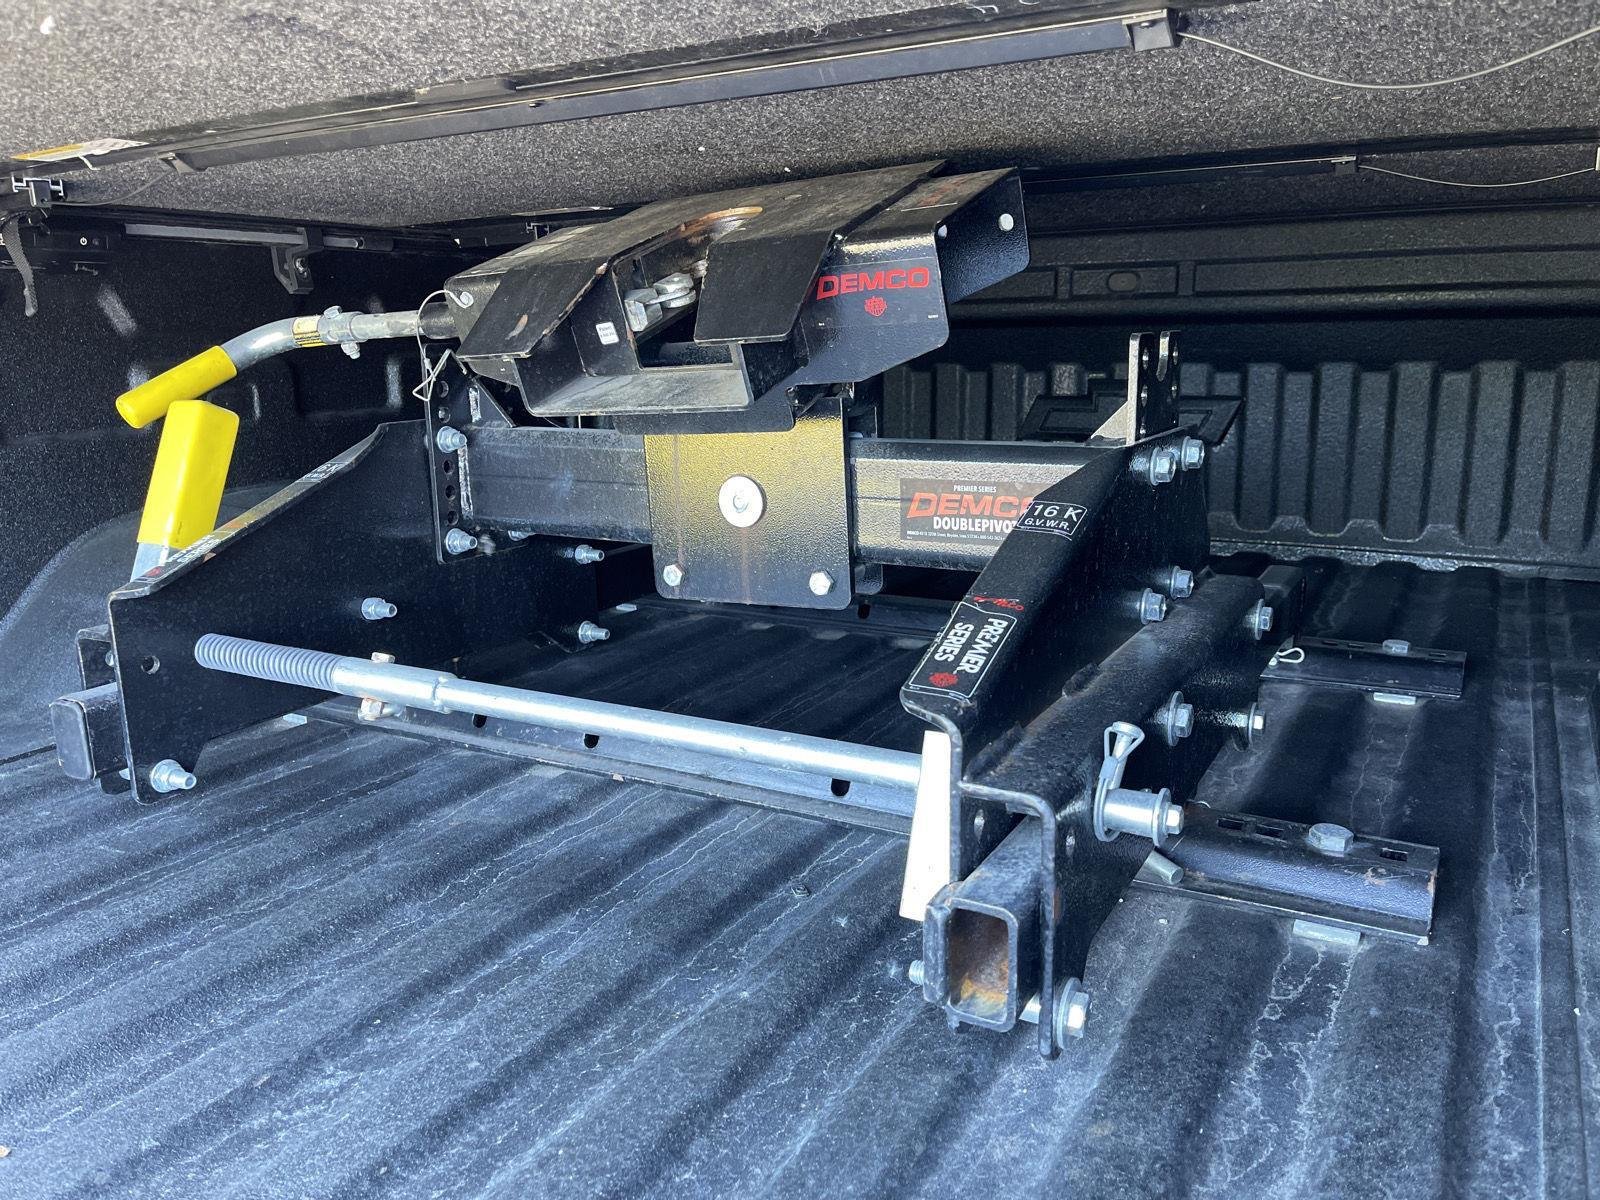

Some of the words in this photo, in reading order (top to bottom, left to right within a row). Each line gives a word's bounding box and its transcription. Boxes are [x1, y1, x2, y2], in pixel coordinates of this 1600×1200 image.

[816, 266, 930, 300] DEMCO
[953, 485, 978, 493] PREMIER
[1024, 518, 1071, 531] G.V.W.R.
[1033, 504, 1059, 517] 16
[1064, 508, 1083, 522] K
[934, 622, 975, 662] SERIES
[957, 618, 1009, 674] PREMIER
